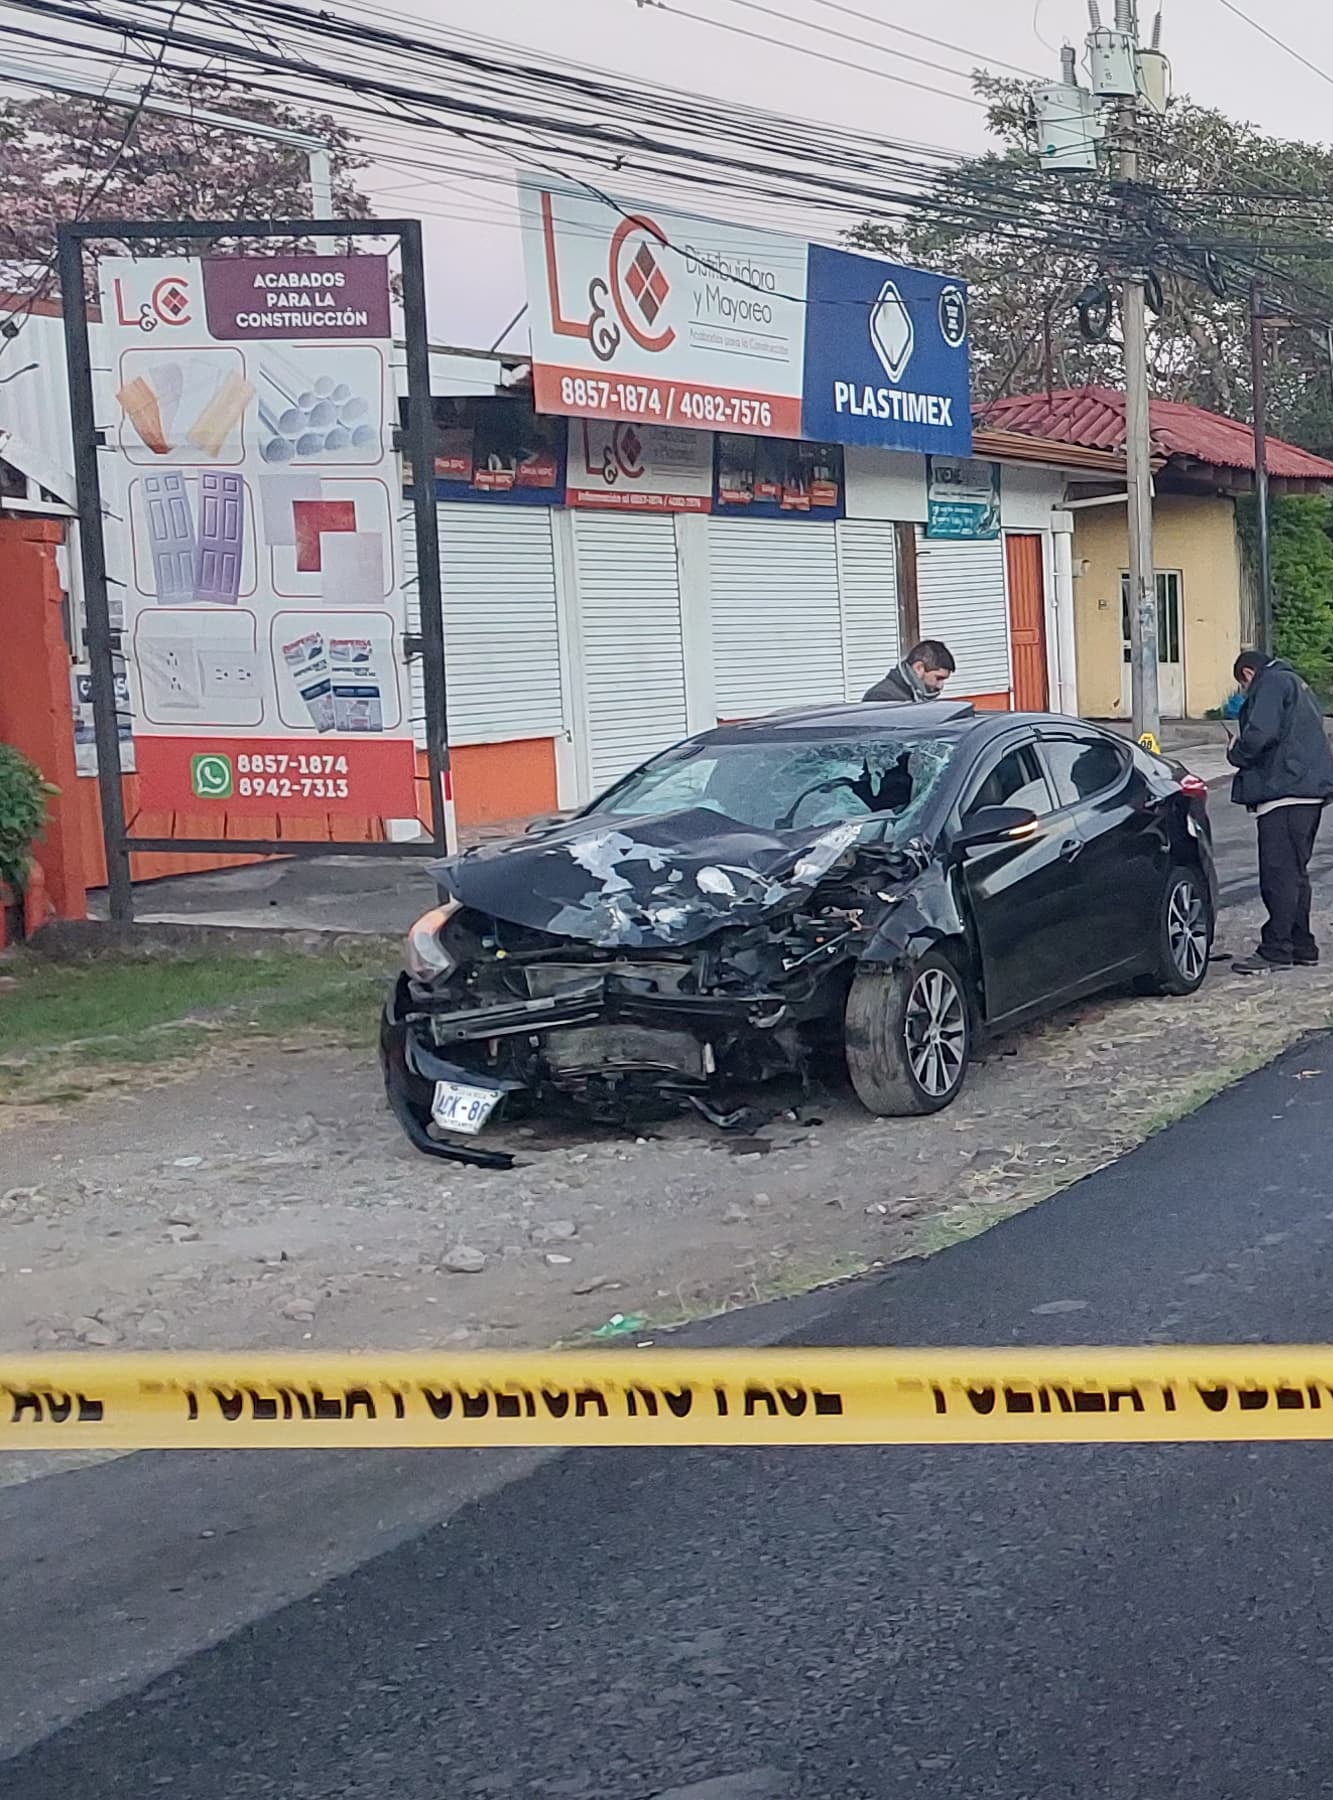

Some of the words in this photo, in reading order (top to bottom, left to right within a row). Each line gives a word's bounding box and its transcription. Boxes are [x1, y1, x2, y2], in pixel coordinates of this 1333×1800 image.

[685, 244, 775, 291] Distribuidora
[253, 272, 345, 289] ACABADOS
[267, 292, 311, 308] PARA
[315, 292, 335, 307] LA
[693, 289, 702, 317] y
[706, 284, 772, 324] Mayoreo
[236, 307, 368, 329] CONSTRUCCIÓN
[560, 377, 662, 415] 8857-1874
[666, 387, 675, 419] /
[680, 391, 772, 426] 4082-7576
[834, 381, 953, 427] PLASTIMEX
[237, 754, 349, 774] 8857-1874
[239, 778, 349, 798] 8942-7313
